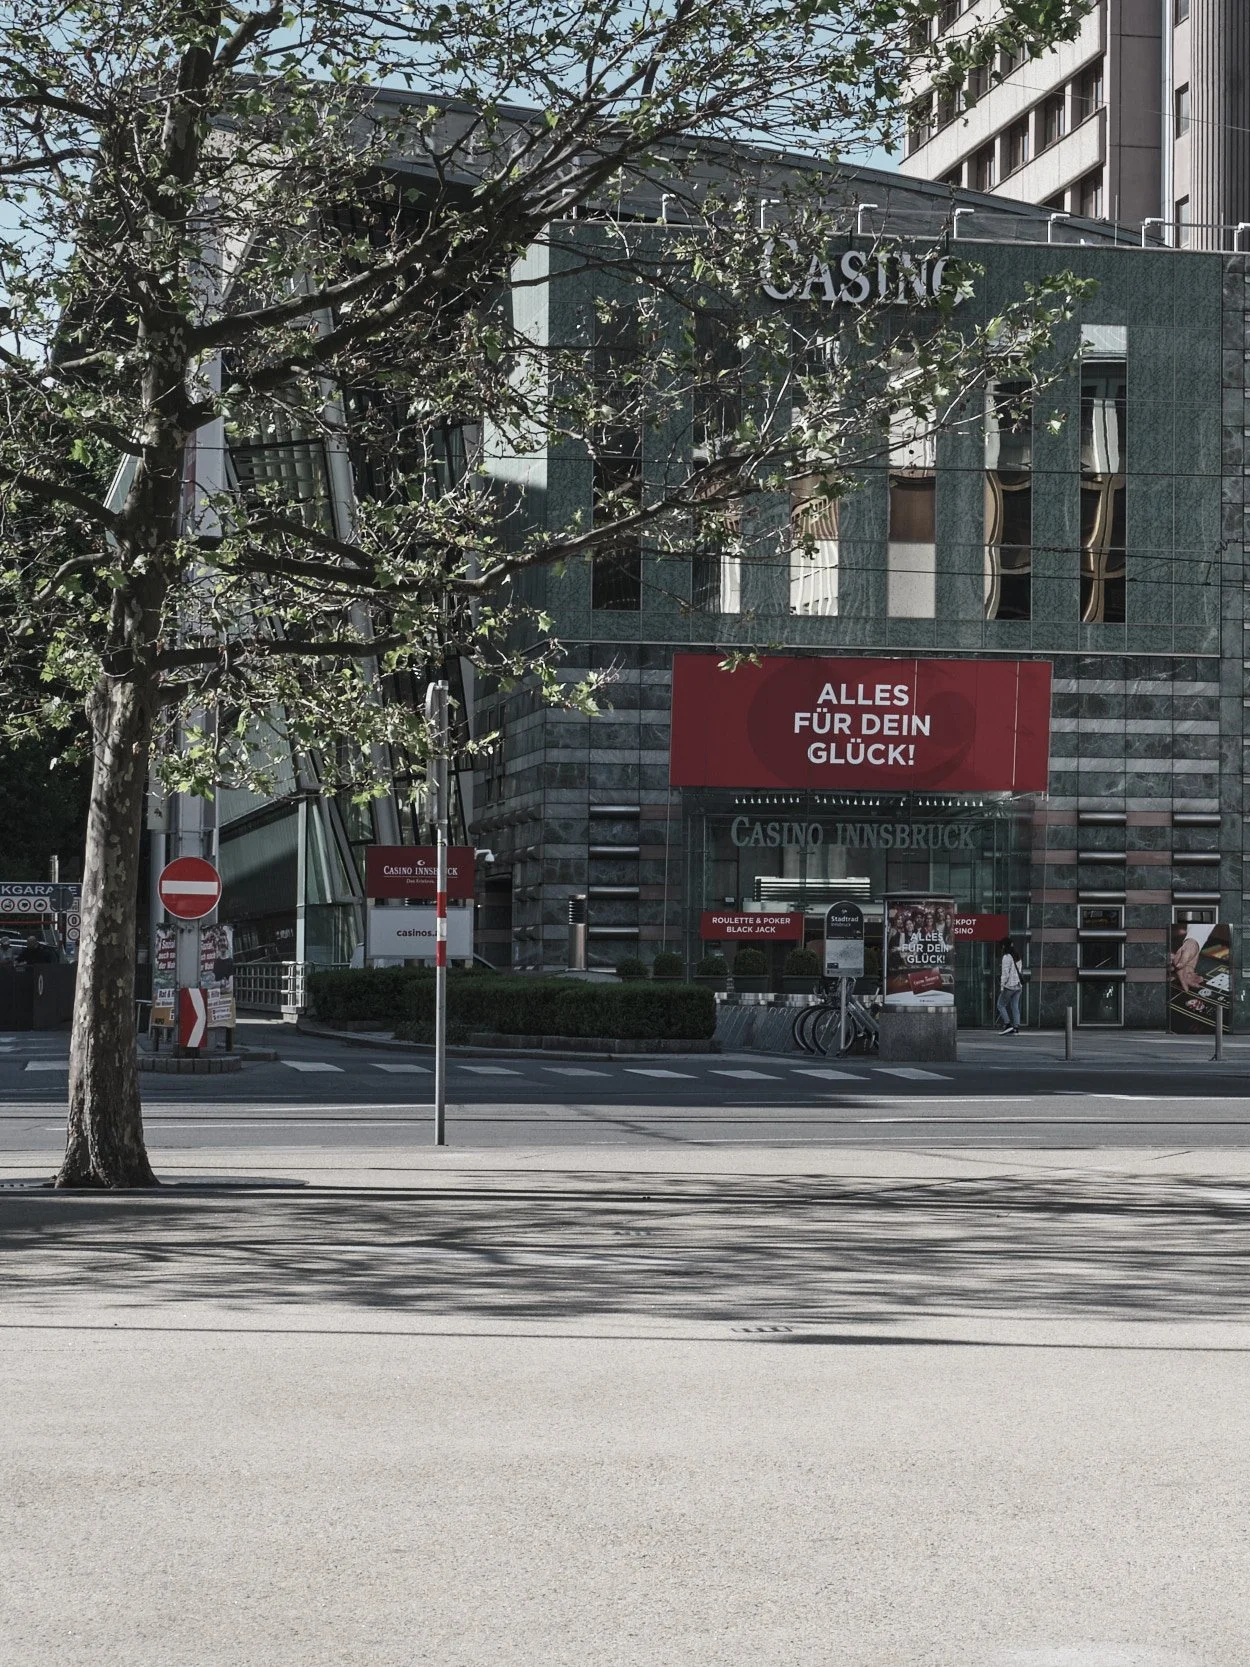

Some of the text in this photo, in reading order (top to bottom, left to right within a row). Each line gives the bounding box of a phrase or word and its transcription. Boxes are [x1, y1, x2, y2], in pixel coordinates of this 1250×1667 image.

[761, 236, 964, 307] CASINO
[817, 683, 910, 707] ALLES
[794, 707, 931, 737] FÜR DEIN
[807, 738, 915, 766] GLÜCK!
[731, 816, 976, 849] CASINO INNSBRUCK
[383, 865, 413, 875] CASINO
[1, 885, 78, 895] KGARAE
[763, 917, 791, 925] POKER
[831, 915, 859, 923] Stadtrad
[954, 918, 977, 926] KPOT
[954, 927, 974, 935] SINO
[910, 932, 944, 942] ALLES
[901, 942, 949, 953] FÜR DEIN
[907, 952, 946, 964] GLÜCK!
